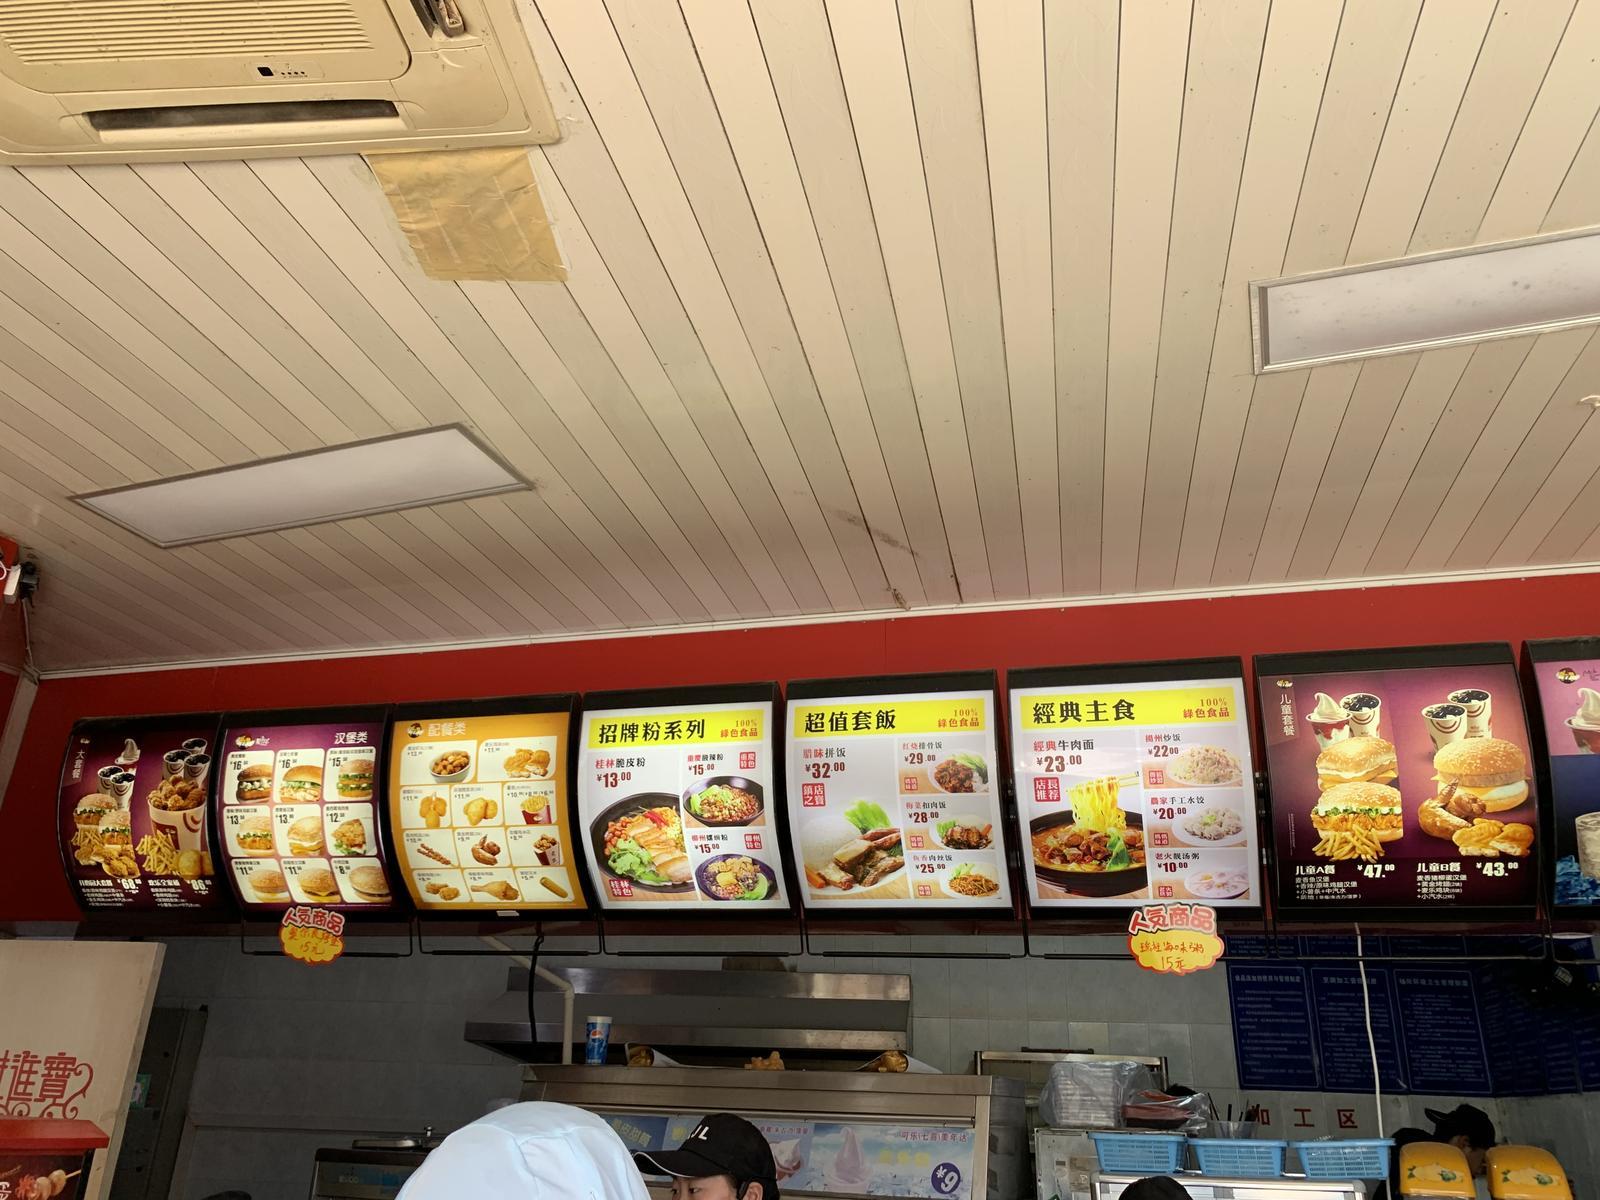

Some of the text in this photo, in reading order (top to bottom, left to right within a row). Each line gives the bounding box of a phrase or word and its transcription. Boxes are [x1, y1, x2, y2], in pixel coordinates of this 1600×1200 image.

[1200, 698, 1227, 707] 100%
[1033, 699, 1136, 724] 經典主食
[1280, 693, 1295, 736] 儿童套餐
[804, 709, 896, 733] 超值套飯
[427, 722, 467, 737] 配餐类
[598, 719, 705, 744] 招牌粉系列
[334, 731, 368, 745] 汉堡类
[1033, 739, 1094, 752] 經典牛肉面
[595, 757, 646, 769] 桂林脆皮粉
[904, 752, 936, 764] ¥29.00
[1036, 754, 1083, 773] ¥23.00
[689, 763, 715, 776] ¥15.00
[805, 761, 845, 779] ¥32.00
[597, 771, 631, 788] ¥13.00
[908, 811, 939, 823] ¥28.00
[1153, 808, 1187, 820] ¥20.00
[915, 863, 946, 874] ¥25.00
[1157, 862, 1188, 873] ¥10.00
[1295, 865, 1335, 876] 儿童A餐
[1357, 864, 1395, 878] ¥47.00
[1416, 862, 1462, 873] 儿童B餐
[1476, 862, 1518, 876] ¥43.00
[1161, 955, 1186, 970] 15元
